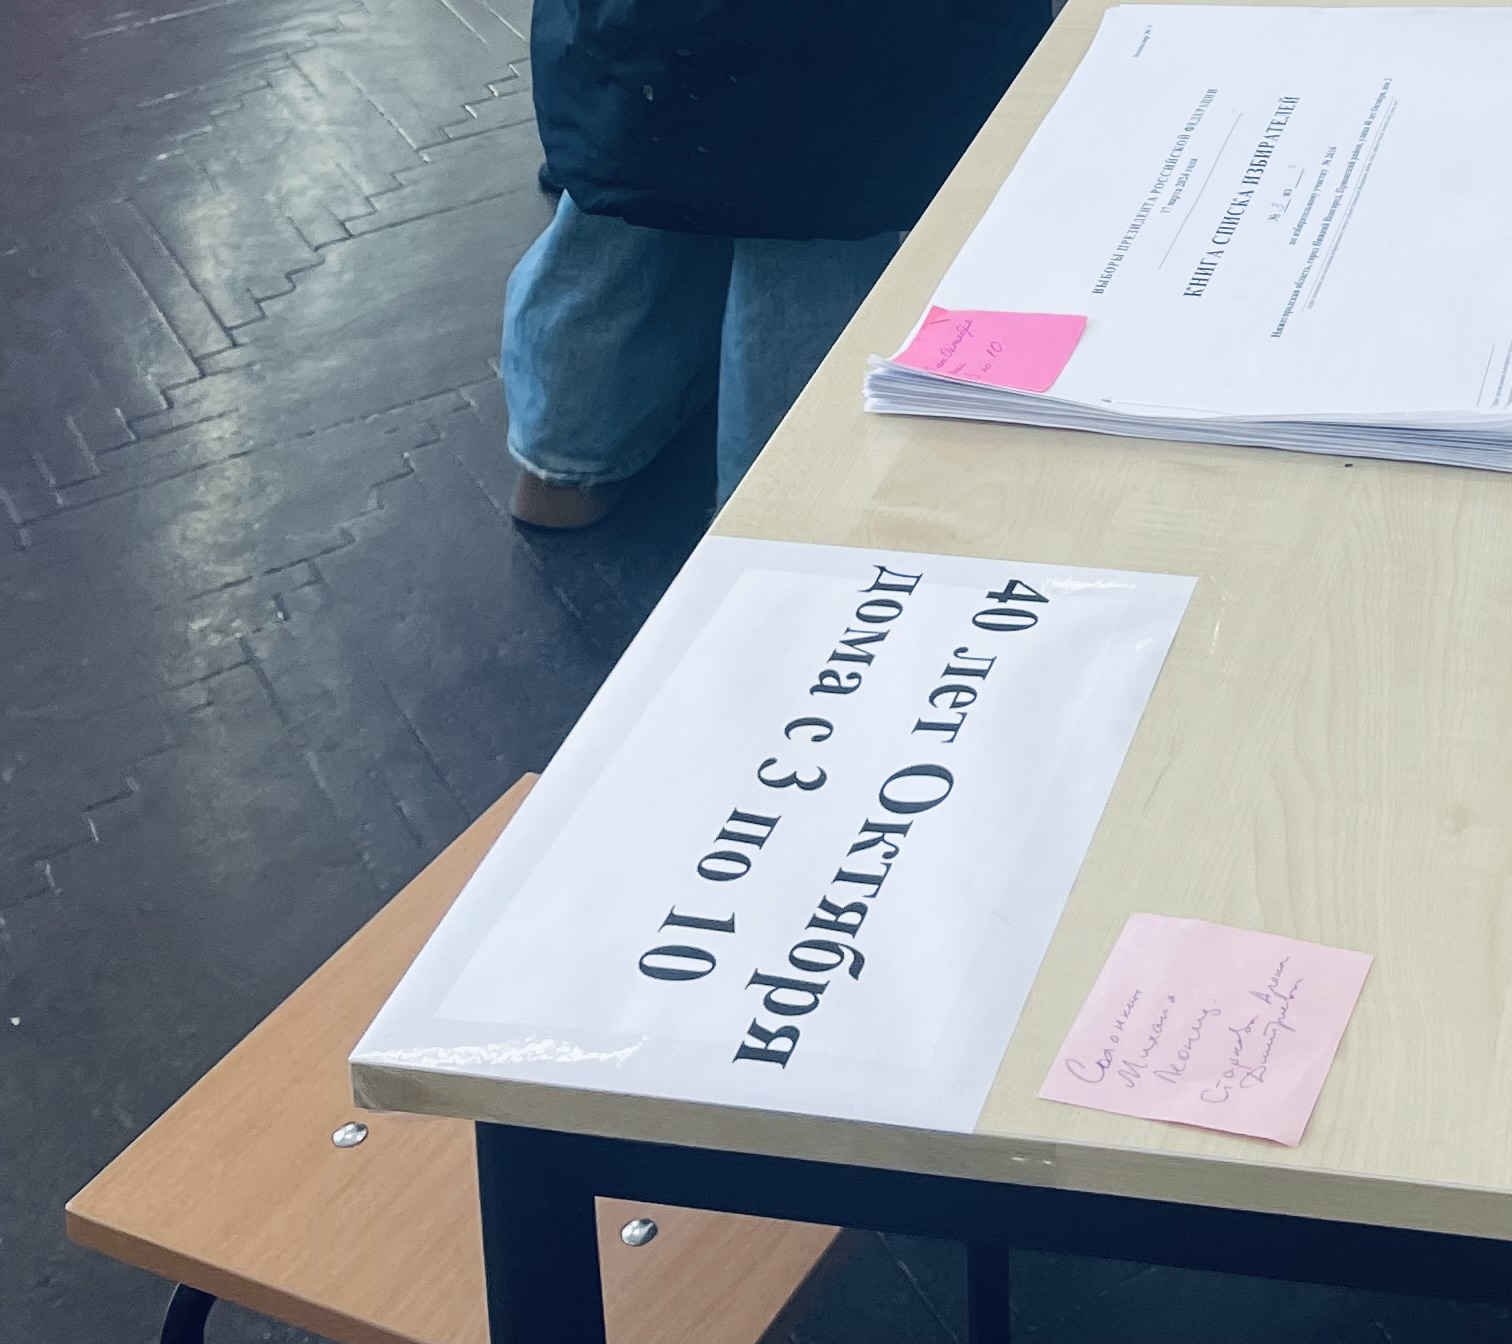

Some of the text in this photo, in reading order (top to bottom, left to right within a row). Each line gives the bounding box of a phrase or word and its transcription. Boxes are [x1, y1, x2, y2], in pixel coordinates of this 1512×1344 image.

[1092, 88, 1218, 295] ВЫБОРЫ ПРЕЗИДЕНТА РОССИЙСКОЙ ФЕДЕРАЦИИ
[1183, 96, 1300, 297] КНИГА СПИСКА ИЗБИРАТЕЛЕЙ
[637, 565, 925, 983] дома с 3 по 10
[732, 579, 1050, 1070] 40 лет Октября
